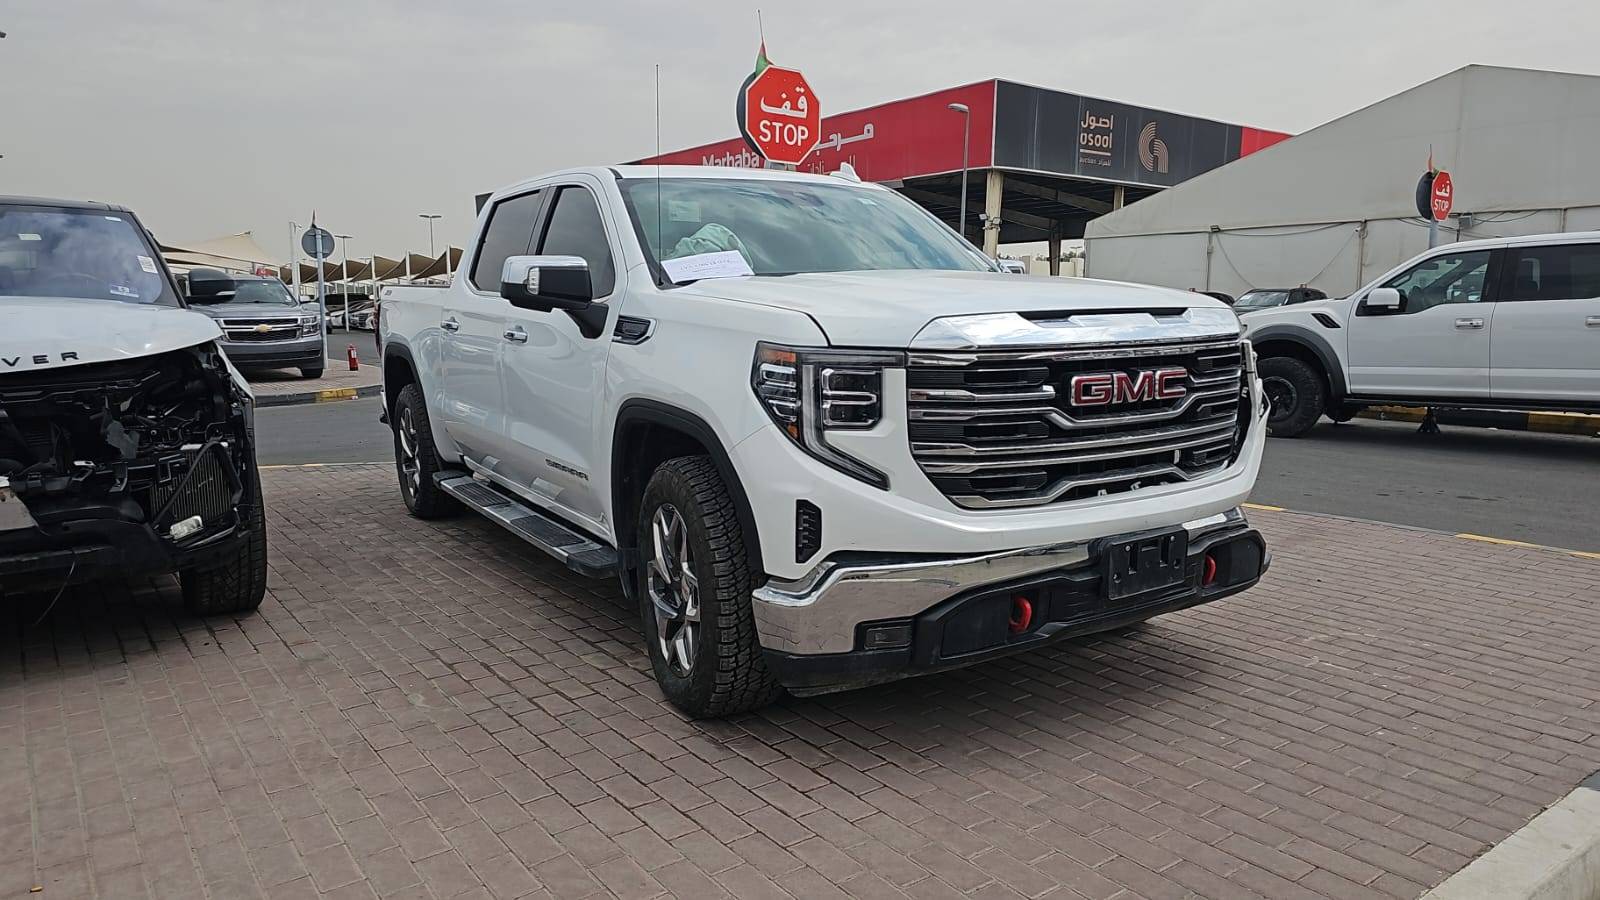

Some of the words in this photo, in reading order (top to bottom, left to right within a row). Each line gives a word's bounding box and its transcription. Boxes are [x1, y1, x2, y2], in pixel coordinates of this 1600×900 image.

[760, 86, 808, 118] قف
[759, 119, 809, 147] STOP
[811, 123, 874, 156] مرحب
[702, 147, 760, 168] Marhaba
[1436, 181, 1450, 197] قف
[1434, 199, 1449, 211] STOP
[1, 351, 80, 367] VER
[1071, 368, 1188, 406] GMC
